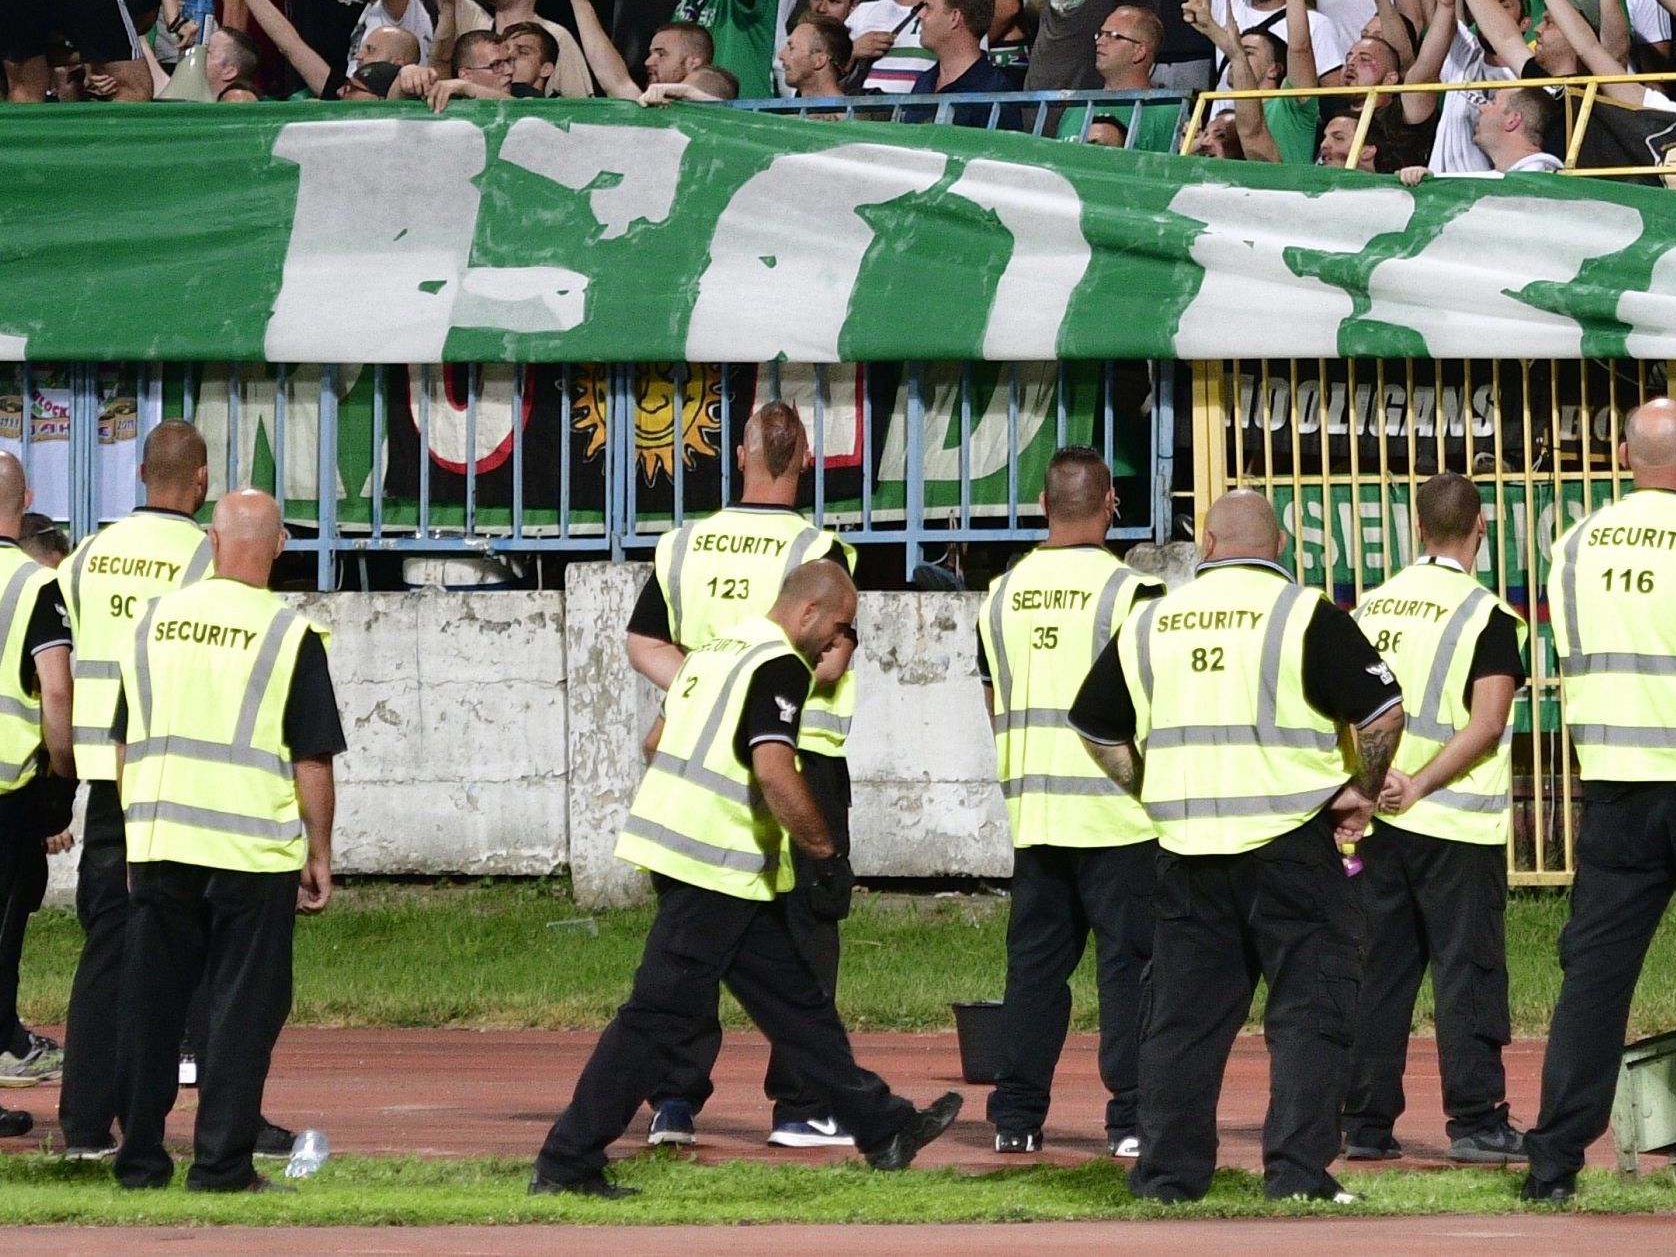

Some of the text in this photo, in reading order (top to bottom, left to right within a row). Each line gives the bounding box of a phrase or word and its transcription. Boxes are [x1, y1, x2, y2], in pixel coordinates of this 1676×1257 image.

[693, 534, 787, 557] SECURITY
[88, 555, 181, 582] SECURITY
[1601, 568, 1655, 593] 116
[707, 577, 750, 600] 123
[1012, 590, 1092, 612] SECURITY
[1364, 598, 1449, 623] SECURITY
[1157, 610, 1263, 633] SECURITY
[154, 620, 257, 651] SECURITY
[1032, 626, 1058, 650] 35
[1192, 647, 1224, 672] 82
